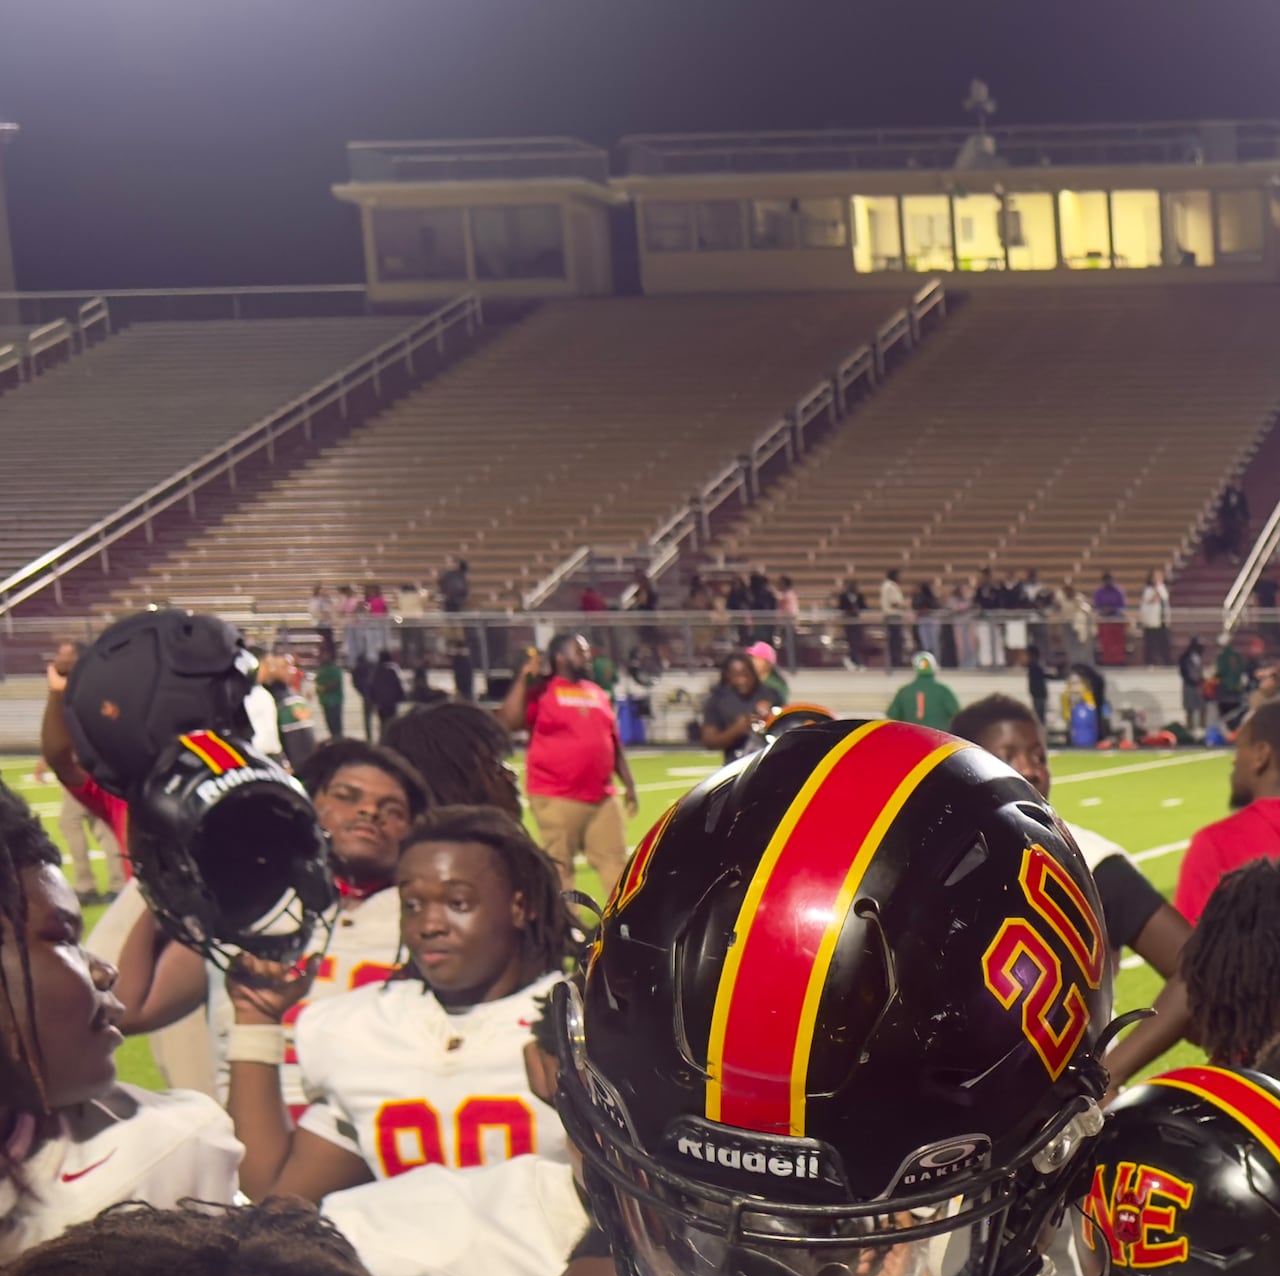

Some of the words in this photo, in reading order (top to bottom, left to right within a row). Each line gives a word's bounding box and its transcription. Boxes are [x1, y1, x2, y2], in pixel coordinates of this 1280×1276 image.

[981, 845, 1105, 1081] 20
[677, 1136, 819, 1179] Riddell
[1082, 1161, 1194, 1269] NE
